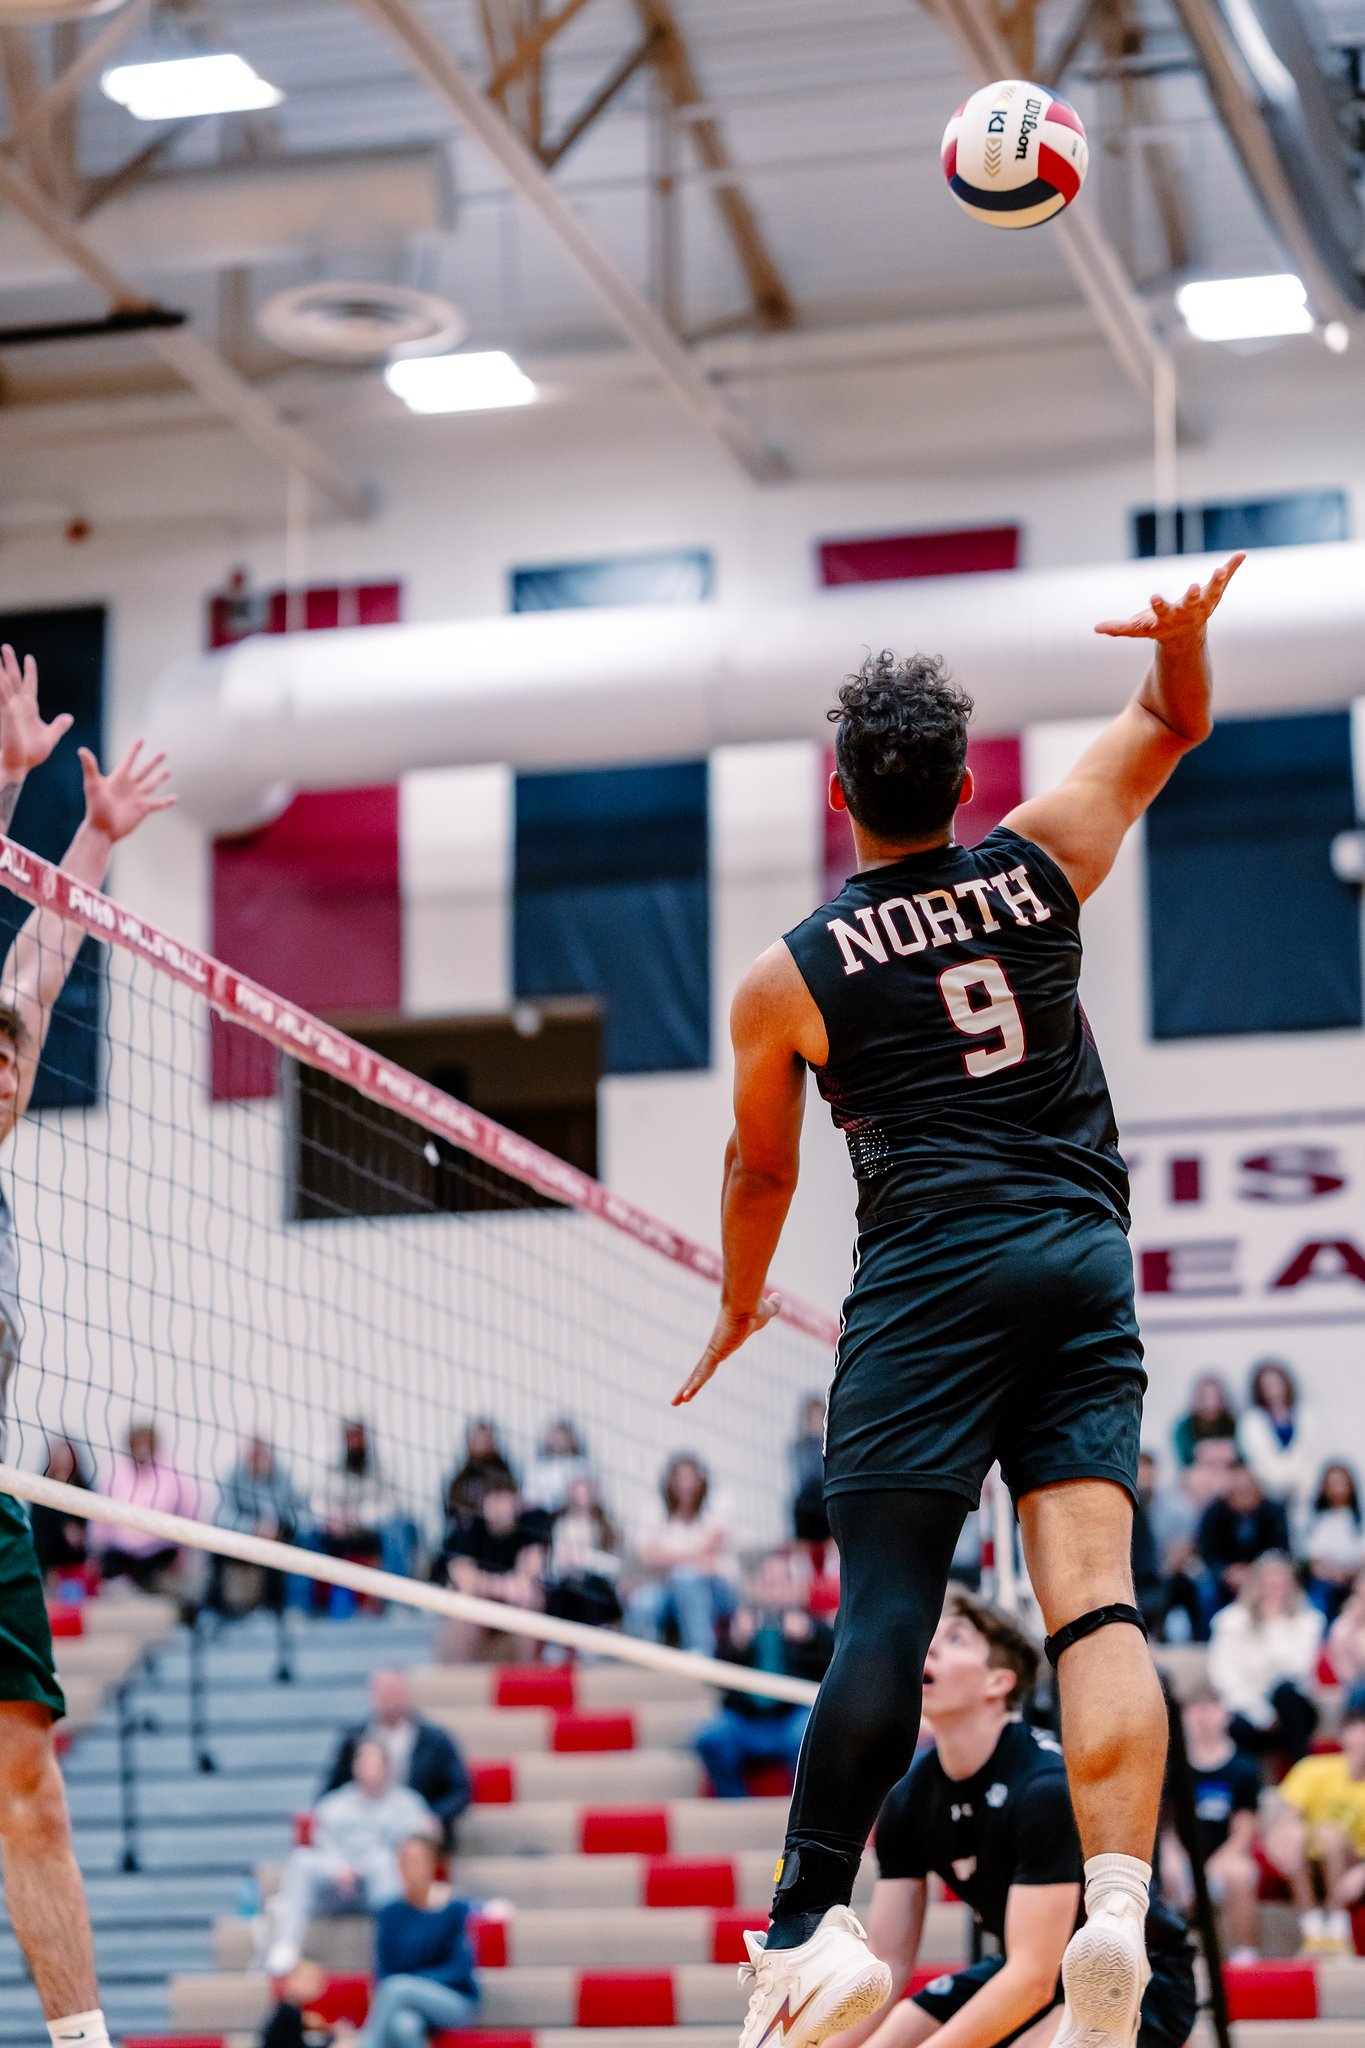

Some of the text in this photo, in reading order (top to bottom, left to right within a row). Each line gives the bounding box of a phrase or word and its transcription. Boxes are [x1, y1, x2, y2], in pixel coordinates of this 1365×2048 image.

[1015, 98, 1042, 161] Wilson
[826, 864, 1052, 976] NORTH
[936, 955, 1027, 1079] 9
[1126, 1145, 1346, 1209] IS
